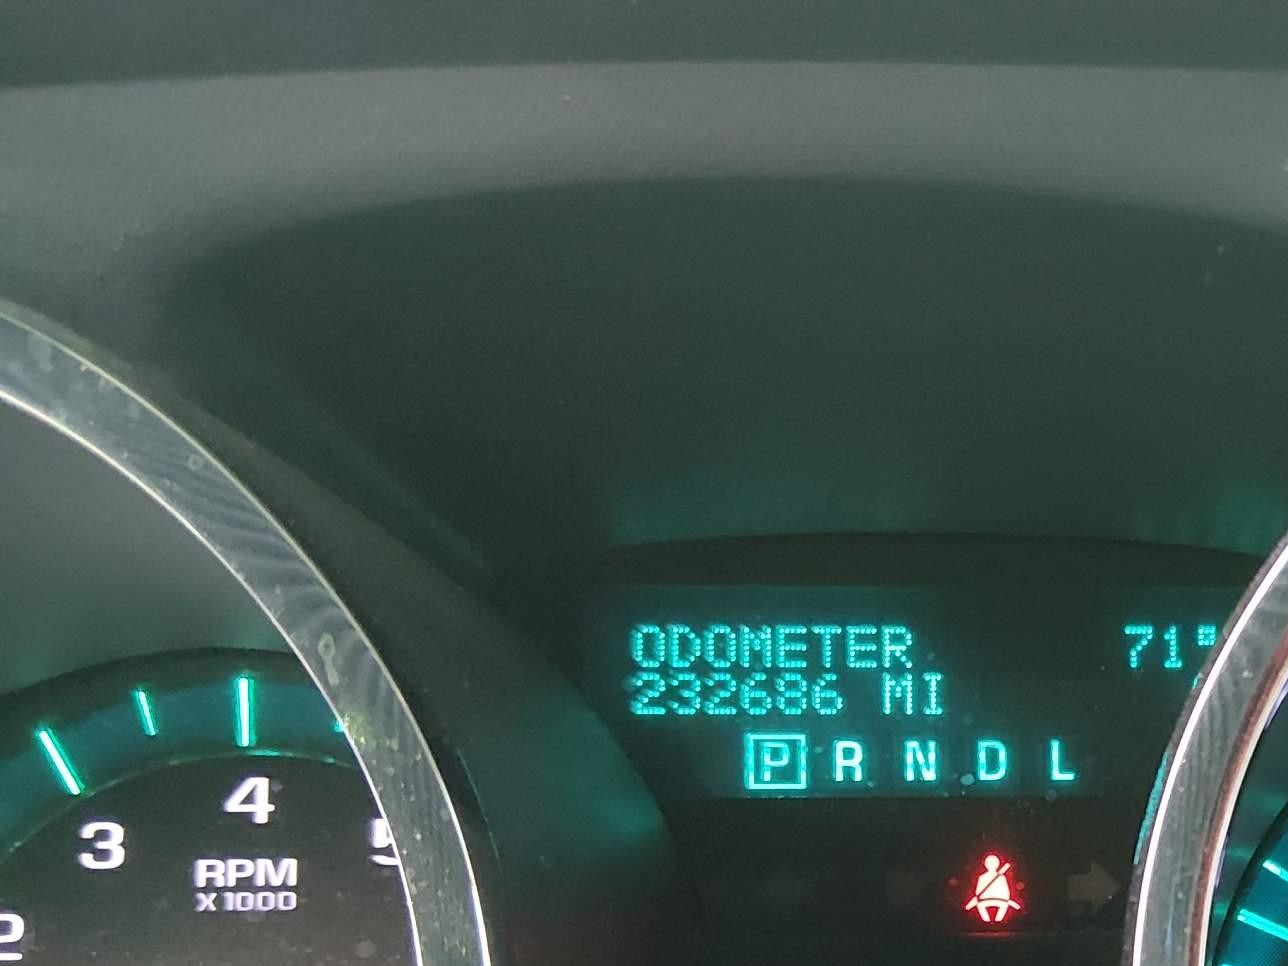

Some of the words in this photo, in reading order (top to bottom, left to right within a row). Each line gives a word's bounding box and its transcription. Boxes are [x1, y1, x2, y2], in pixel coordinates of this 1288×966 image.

[630, 624, 914, 669] ODOMETER
[630, 673, 845, 716] 232686
[881, 673, 944, 716] MI
[763, 745, 791, 783] P
[834, 740, 865, 782] R
[905, 740, 937, 782] N
[978, 740, 1008, 782] D
[1051, 740, 1076, 782] L
[223, 777, 276, 825] 4
[77, 821, 126, 871] 3
[194, 857, 299, 890] RPM
